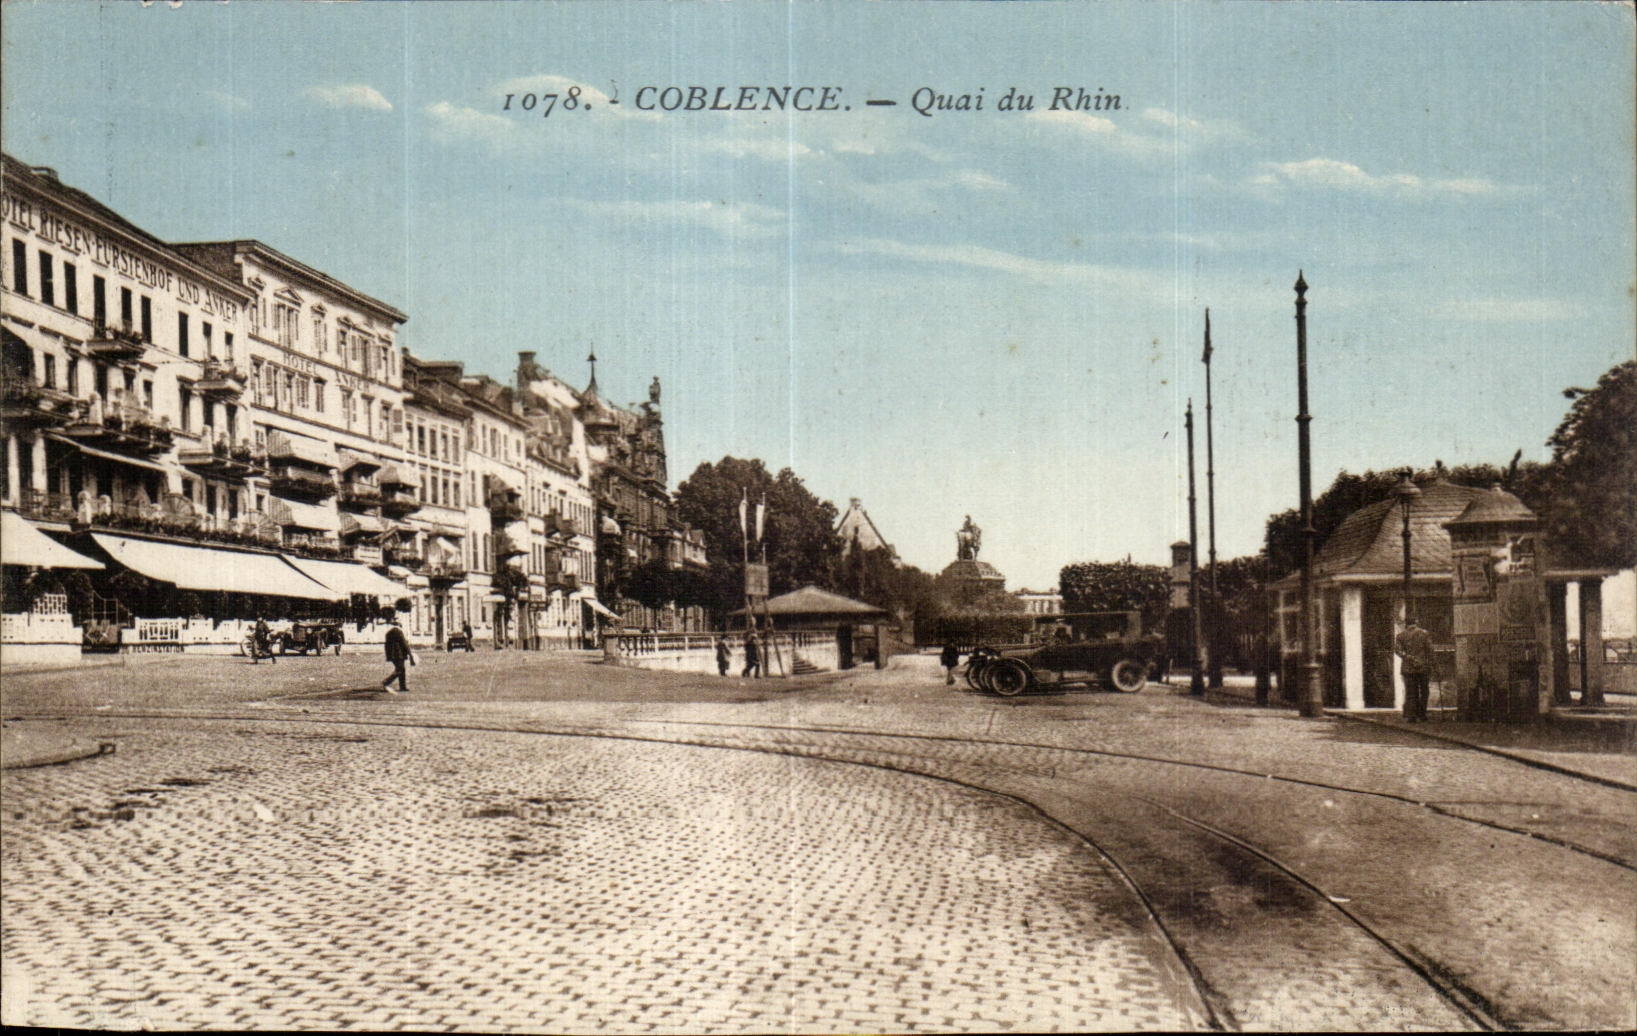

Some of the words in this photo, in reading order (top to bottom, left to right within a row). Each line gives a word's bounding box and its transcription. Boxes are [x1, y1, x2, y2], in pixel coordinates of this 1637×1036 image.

[177, 277, 200, 304] UND
[203, 288, 237, 321] ANKER
[283, 351, 319, 375] HOTEL
